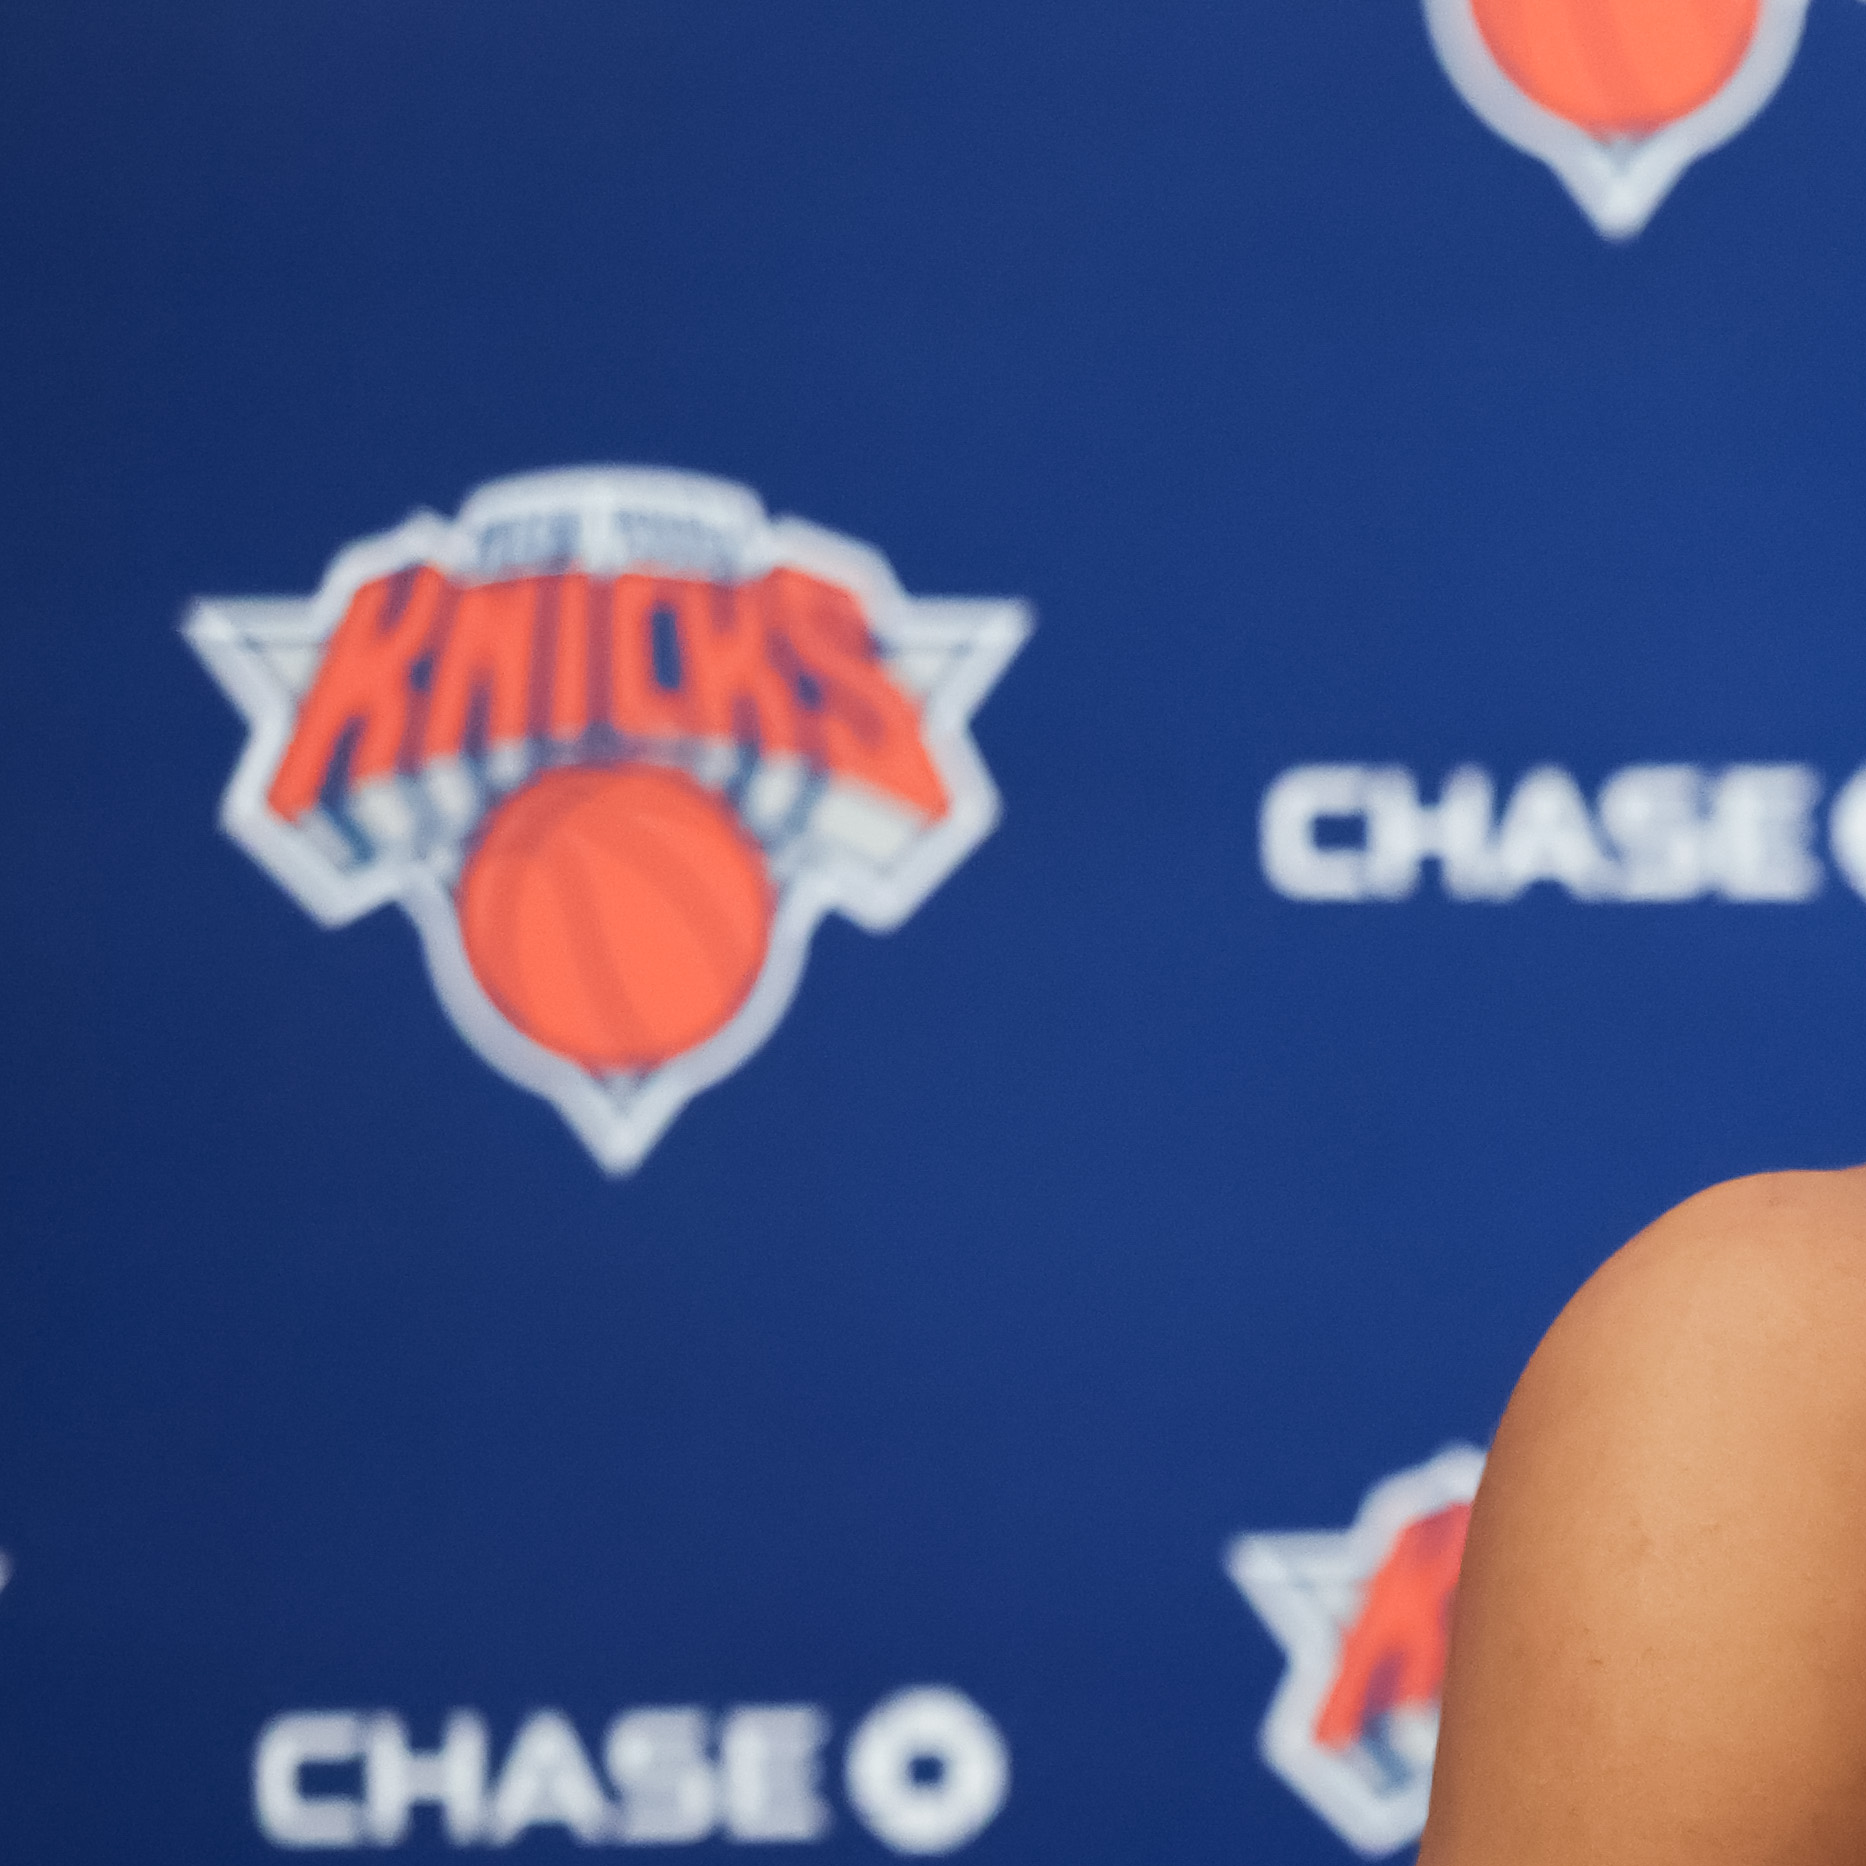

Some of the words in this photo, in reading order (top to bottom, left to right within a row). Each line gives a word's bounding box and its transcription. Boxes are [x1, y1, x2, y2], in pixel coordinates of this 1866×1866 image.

[267, 562, 953, 828] KNICKS
[1260, 762, 1823, 904] CHASE
[255, 1707, 830, 1850] CHASE
